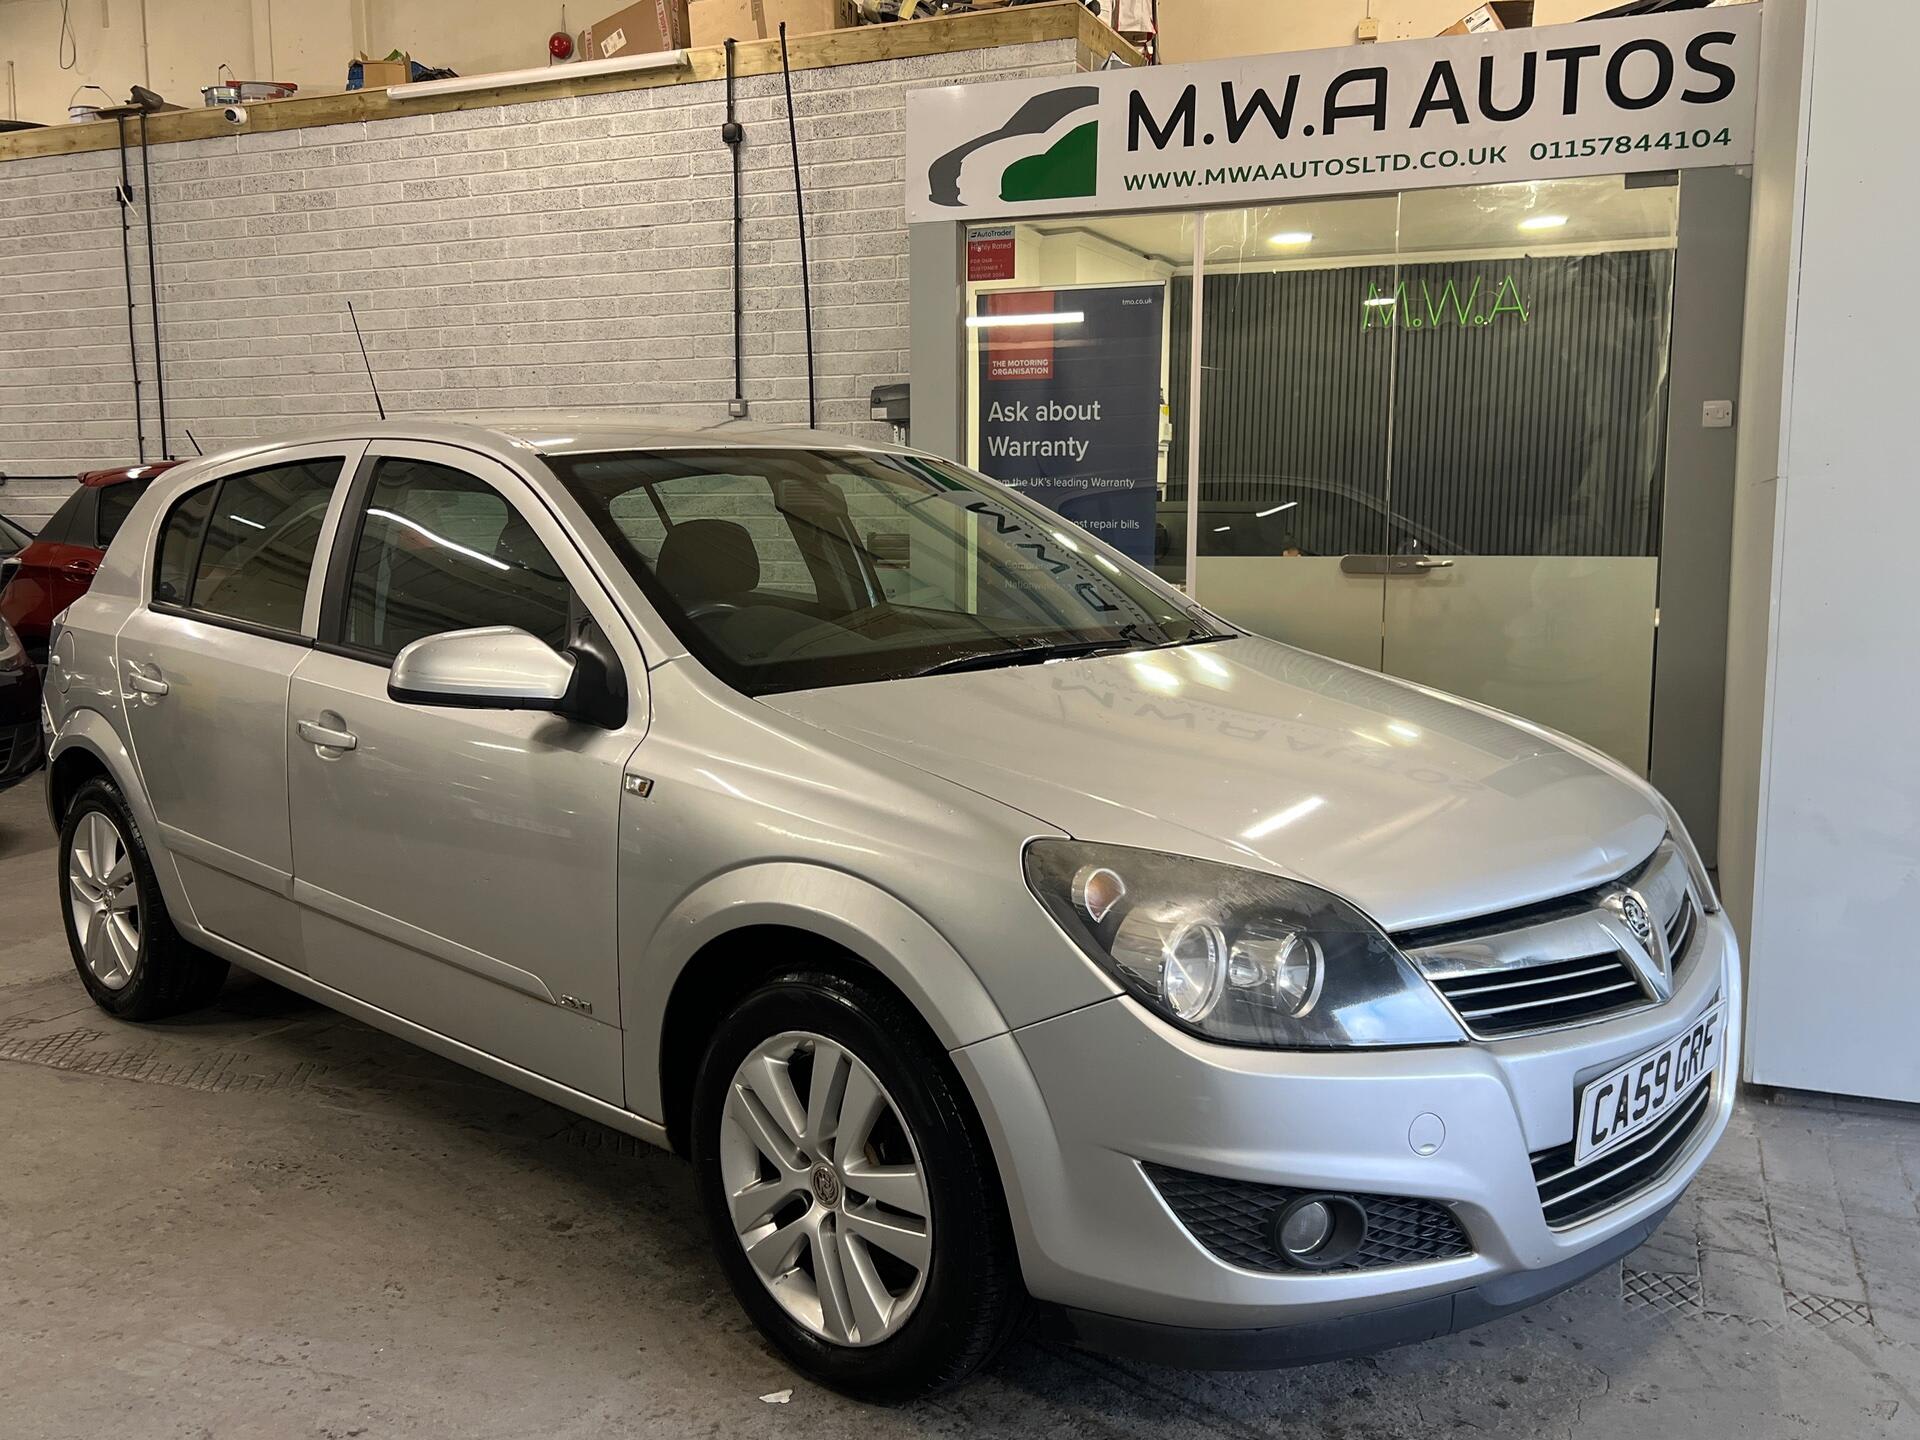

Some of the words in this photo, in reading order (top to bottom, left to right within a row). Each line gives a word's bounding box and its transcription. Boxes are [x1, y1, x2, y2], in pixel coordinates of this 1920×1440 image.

[1127, 66, 1388, 152] M.W.A
[1409, 31, 1737, 129] AUTOS
[1123, 145, 1507, 191] WWW.MWAAUTOSLTD.CO.UK
[1529, 127, 1732, 161] 01157844104
[1122, 297, 1153, 305] tmo.co.uk
[992, 360, 1007, 368] THE
[1007, 358, 1049, 367] MOTORING
[992, 367, 1049, 376] ORGANISATION
[988, 400, 1029, 423] Ask
[1035, 400, 1101, 422] about
[987, 436, 1090, 462] Warranty
[1012, 477, 1028, 487] the
[1030, 477, 1052, 487] UK's
[1053, 477, 1089, 490] leading
[1090, 477, 1135, 490] Warranty
[1089, 519, 1118, 531] repair
[1120, 519, 1140, 529] bills
[1590, 1050, 1672, 1146] CA59
[1673, 1012, 1719, 1093] GRF
